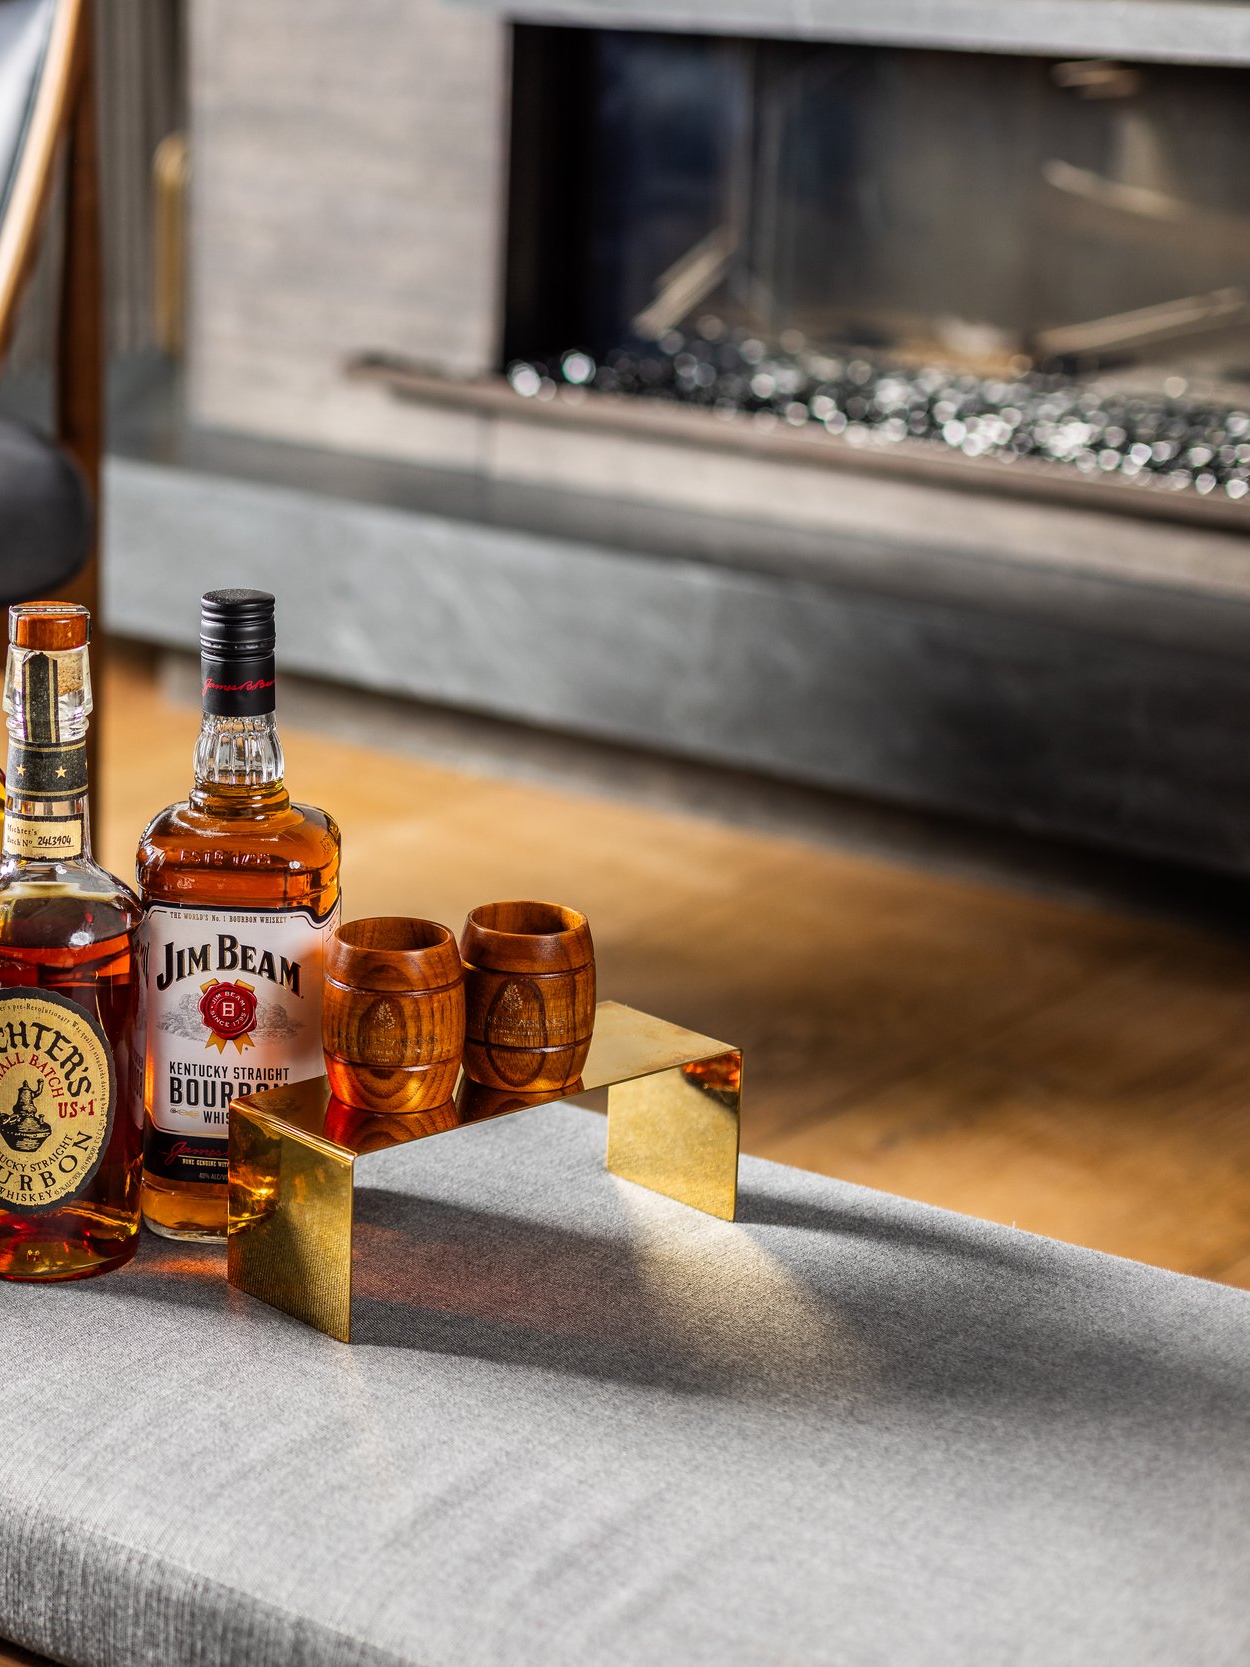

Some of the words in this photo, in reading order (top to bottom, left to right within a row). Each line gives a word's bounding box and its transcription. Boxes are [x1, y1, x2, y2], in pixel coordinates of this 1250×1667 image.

[7, 824, 37, 836] Michter's
[170, 911, 182, 919] THE
[183, 912, 209, 921] WORLD'S
[229, 915, 258, 923] BOURBON
[259, 916, 288, 924] WHISKEY
[156, 941, 212, 991] JIM
[216, 934, 303, 996] BEAM
[211, 993, 223, 1005] JIM
[224, 991, 246, 1007] BEAM
[210, 1010, 230, 1028] SINCE
[71, 1020, 83, 1034] War
[80, 1032, 96, 1051] quality
[93, 1051, 106, 1079] standards
[28, 1054, 65, 1099] BATCH
[169, 1061, 228, 1079] KENTUCKY
[233, 1067, 290, 1081] STRAIGHT
[30, 1134, 74, 1173] STRAIGHT
